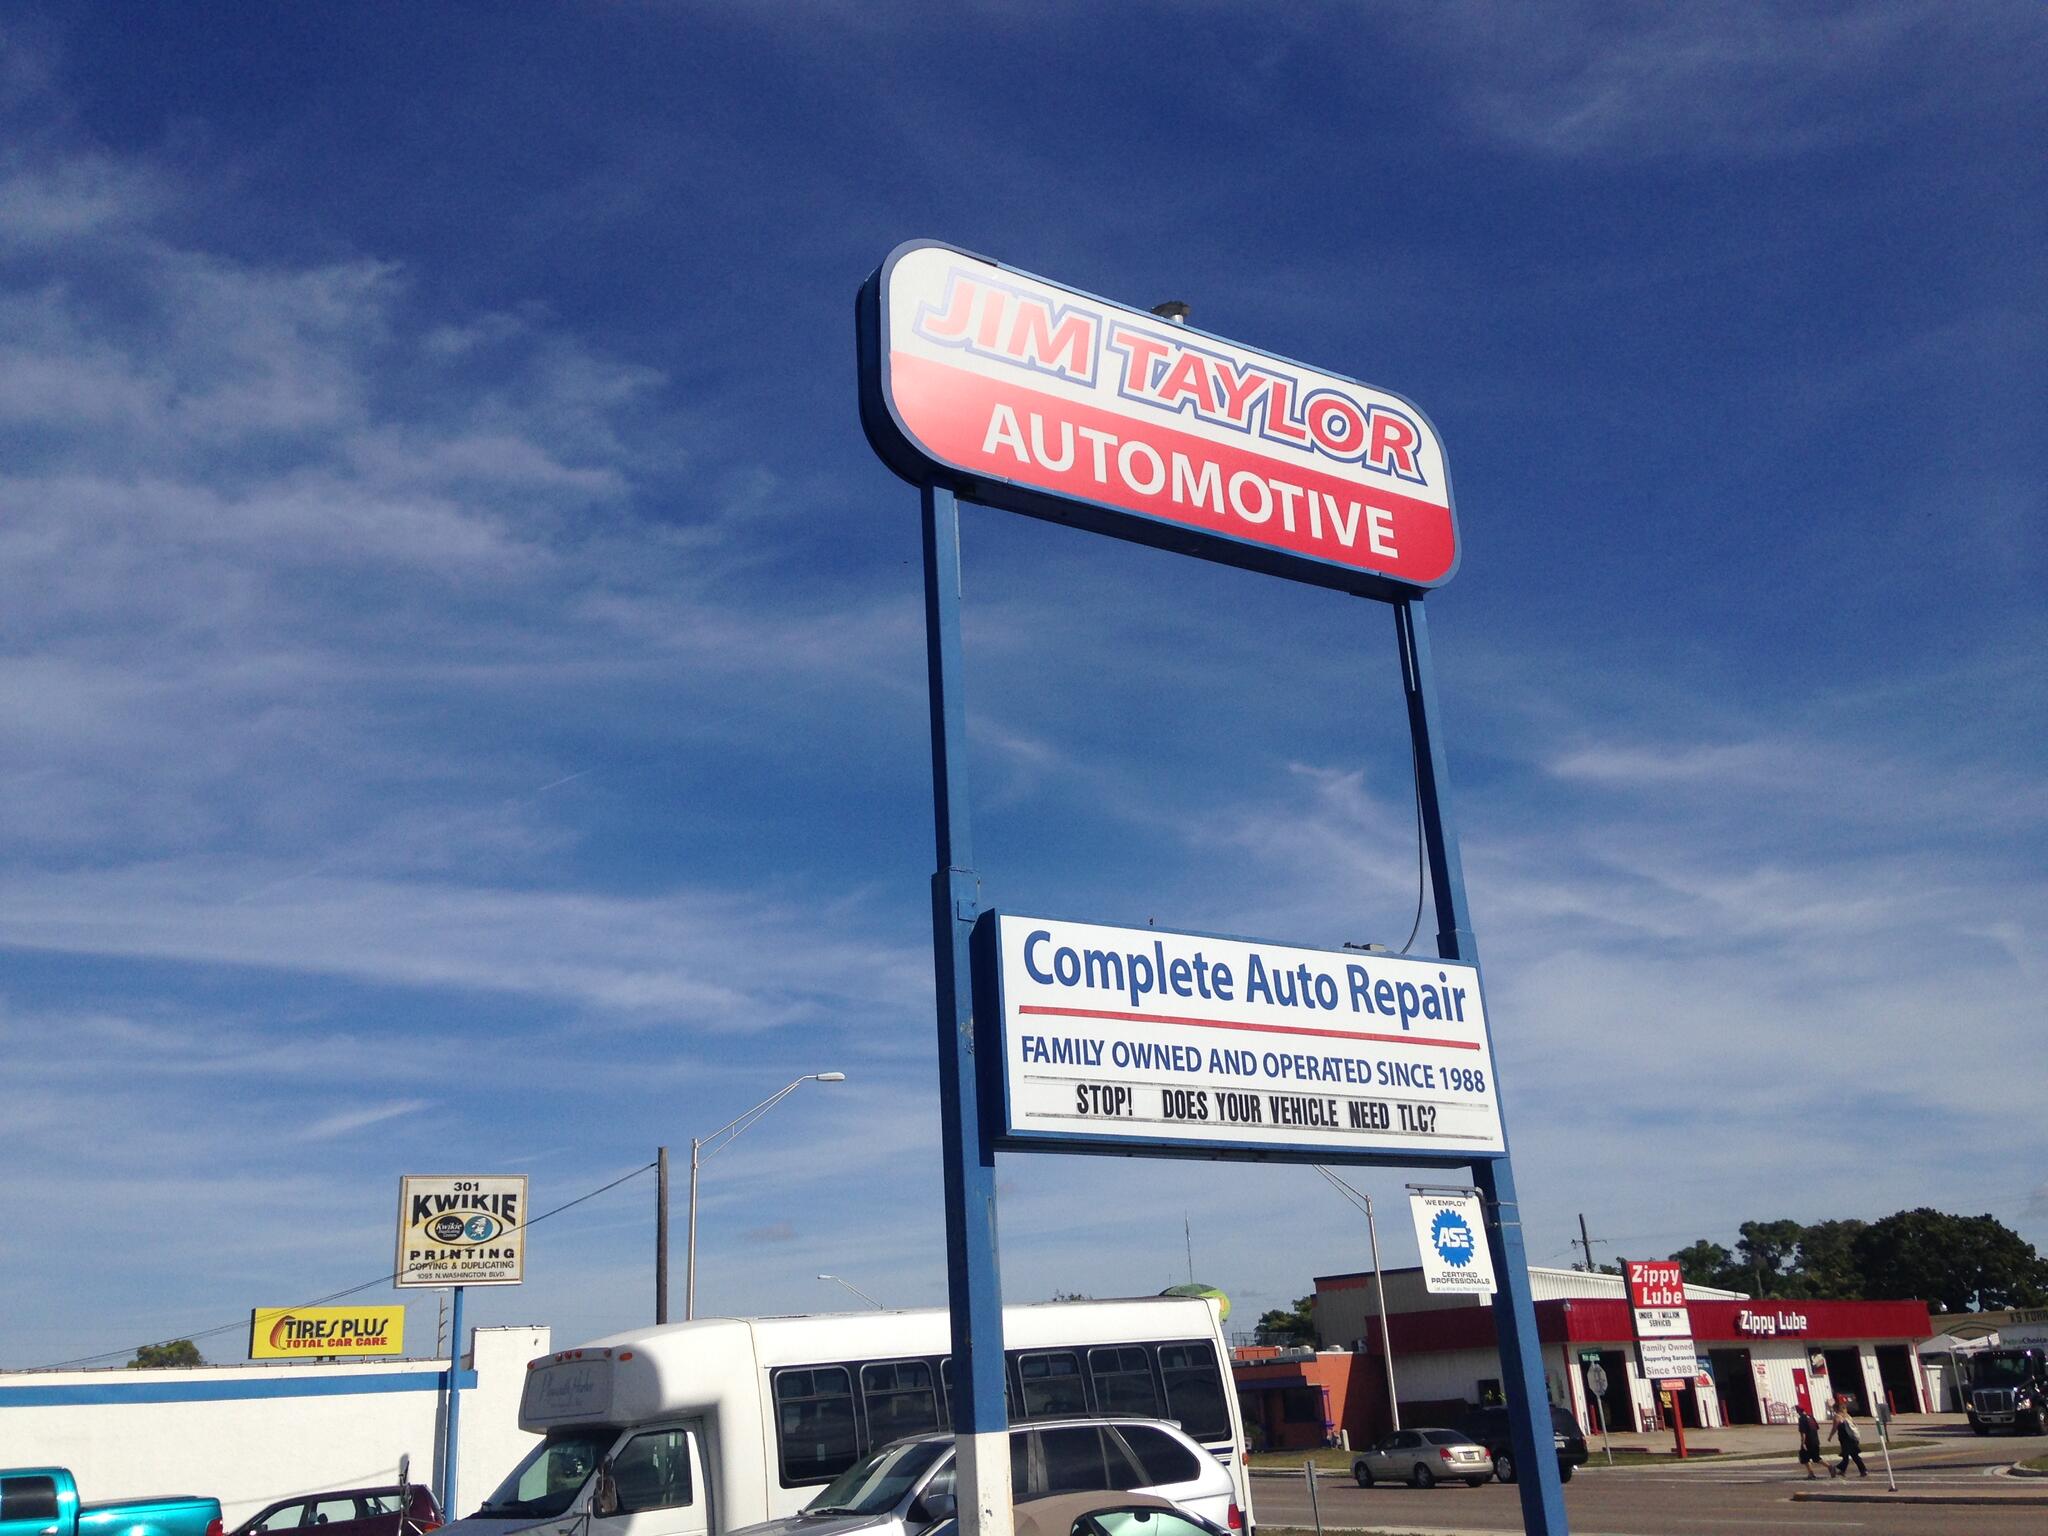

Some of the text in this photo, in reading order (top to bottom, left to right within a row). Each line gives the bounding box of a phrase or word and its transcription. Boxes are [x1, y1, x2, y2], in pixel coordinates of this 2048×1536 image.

[917, 269, 1427, 485] JIM TAYLOR
[982, 403, 1400, 559] AUTOMOTIVE
[1024, 929, 1467, 1030] Complete Auto Repair
[1021, 1035, 1486, 1094] FAMILY OWNED AND OPERATED SINCE 1988
[1076, 1083, 1438, 1134] STOP! DOES YOUR VEHICLE NEED TLC?
[454, 1182, 480, 1192] 301
[412, 1193, 517, 1228] KWIKIE
[1438, 1227, 1469, 1248] ASE
[410, 1248, 515, 1261] PRINTING
[409, 1262, 448, 1271] COPYING
[461, 1261, 514, 1270] DUPLICATING
[1632, 1264, 1679, 1286] Zippy
[1431, 1277, 1490, 1285] PROFESSIONALS
[1643, 1287, 1682, 1305] Lube
[285, 1318, 389, 1339] TIRES PLUS
[1740, 1310, 1808, 1334] Zippy Lube
[286, 1336, 388, 1349] TOTAL CAR CARE
[1642, 1343, 1693, 1353] Family Owned
[1646, 1366, 1670, 1375] Since
[1672, 1364, 1692, 1374] 1989
